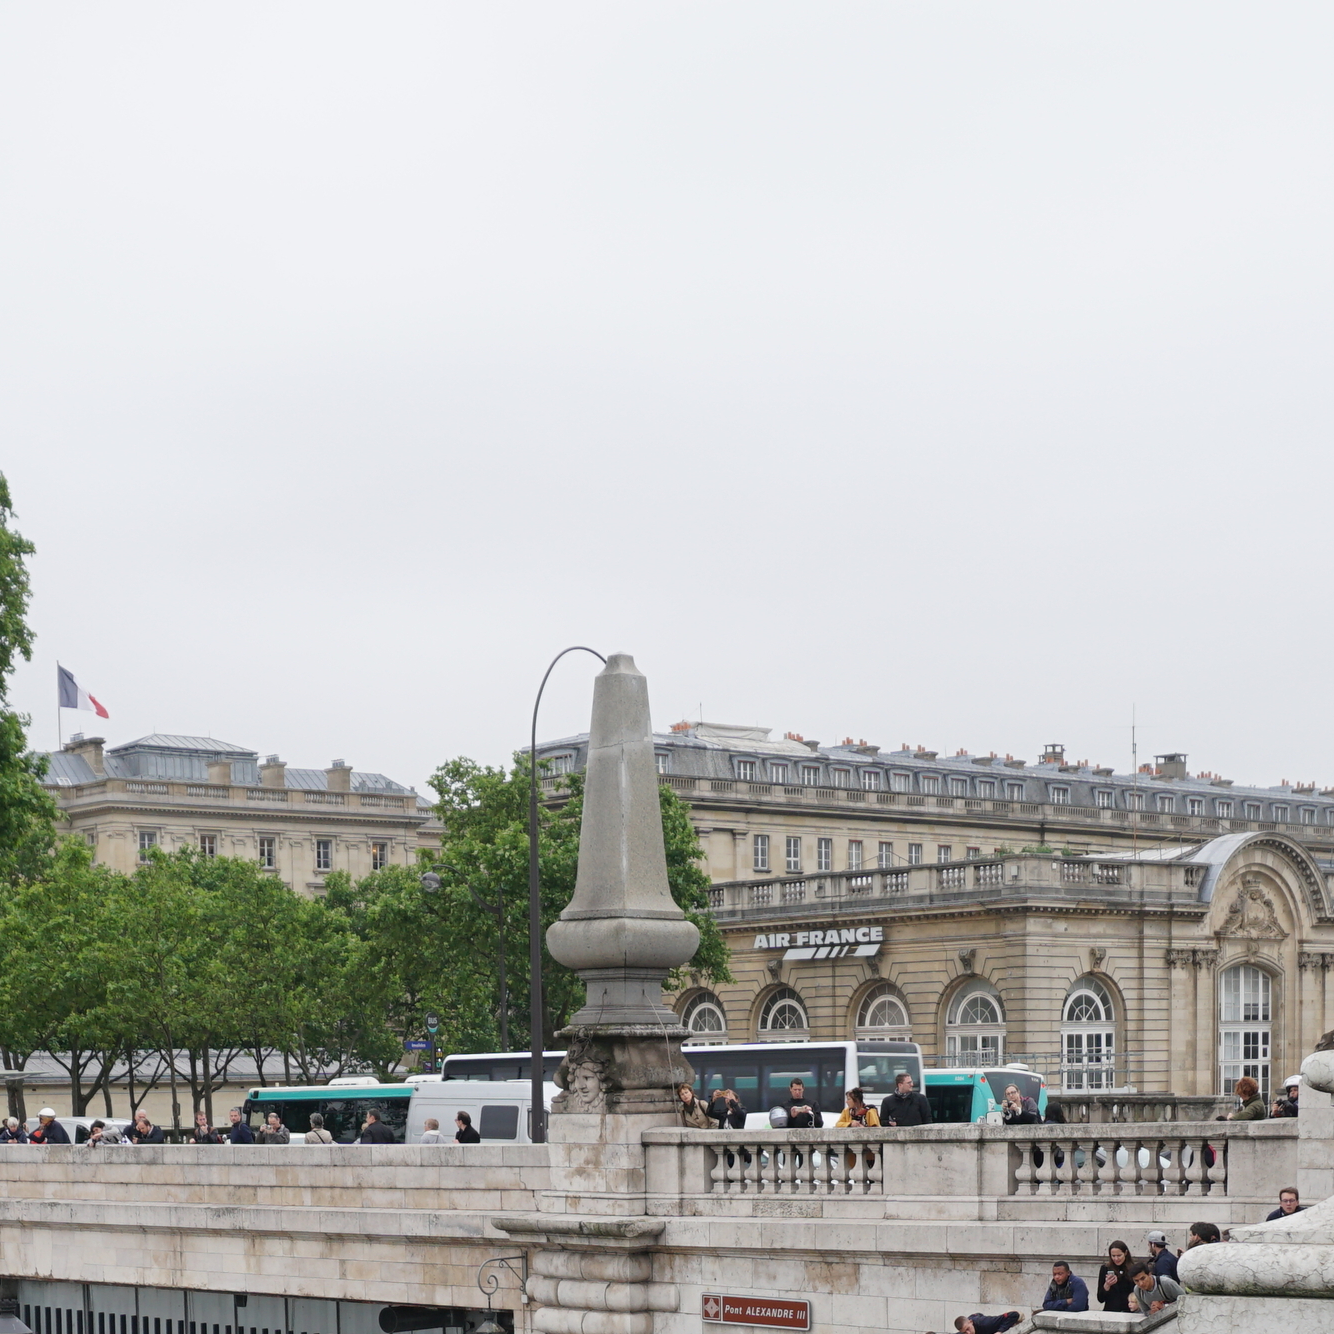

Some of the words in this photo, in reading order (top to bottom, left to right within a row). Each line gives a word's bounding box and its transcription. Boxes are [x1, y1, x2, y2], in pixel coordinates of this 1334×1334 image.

[753, 933, 790, 949] AIR
[797, 926, 883, 946] FRANCE
[725, 1304, 742, 1315] Pont
[746, 1306, 794, 1319] ALEXANDRE
[796, 1310, 806, 1320] III
